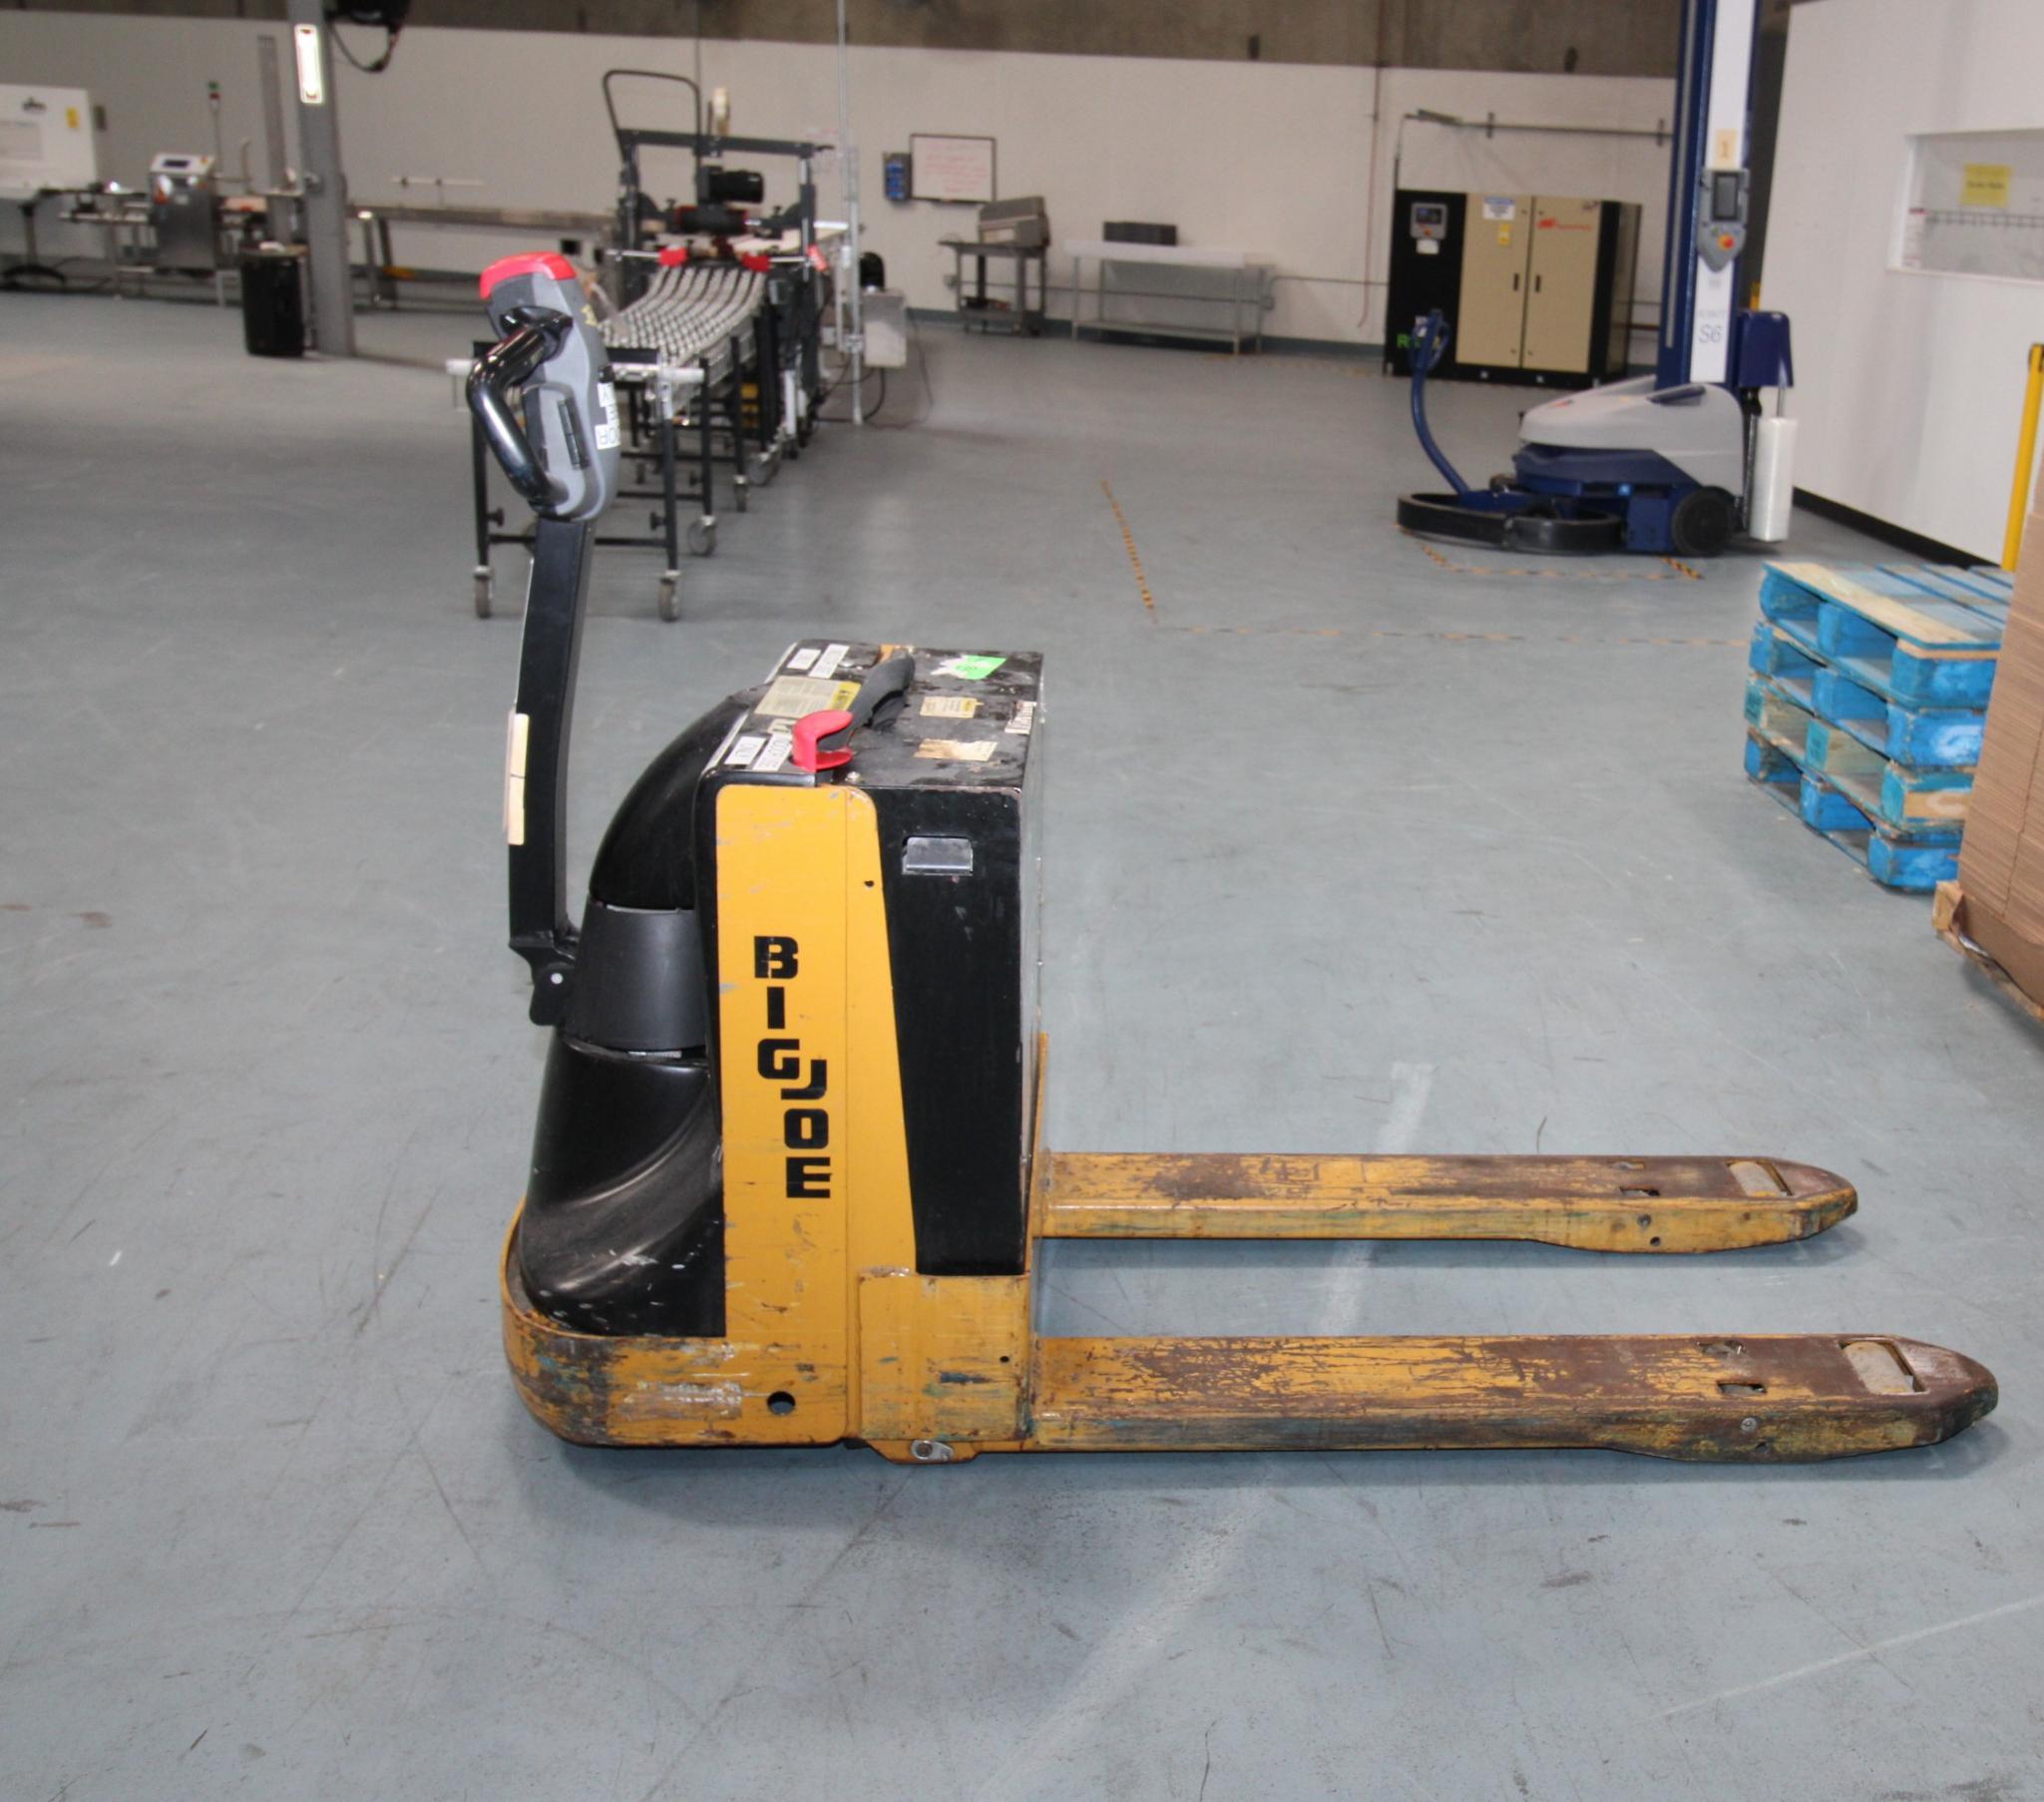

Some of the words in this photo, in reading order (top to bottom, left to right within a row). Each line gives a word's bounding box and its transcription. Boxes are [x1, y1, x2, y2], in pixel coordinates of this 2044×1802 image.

[1699, 323, 1722, 343] S6
[754, 936, 800, 1080] BIG
[780, 1059, 832, 1198] JOE
